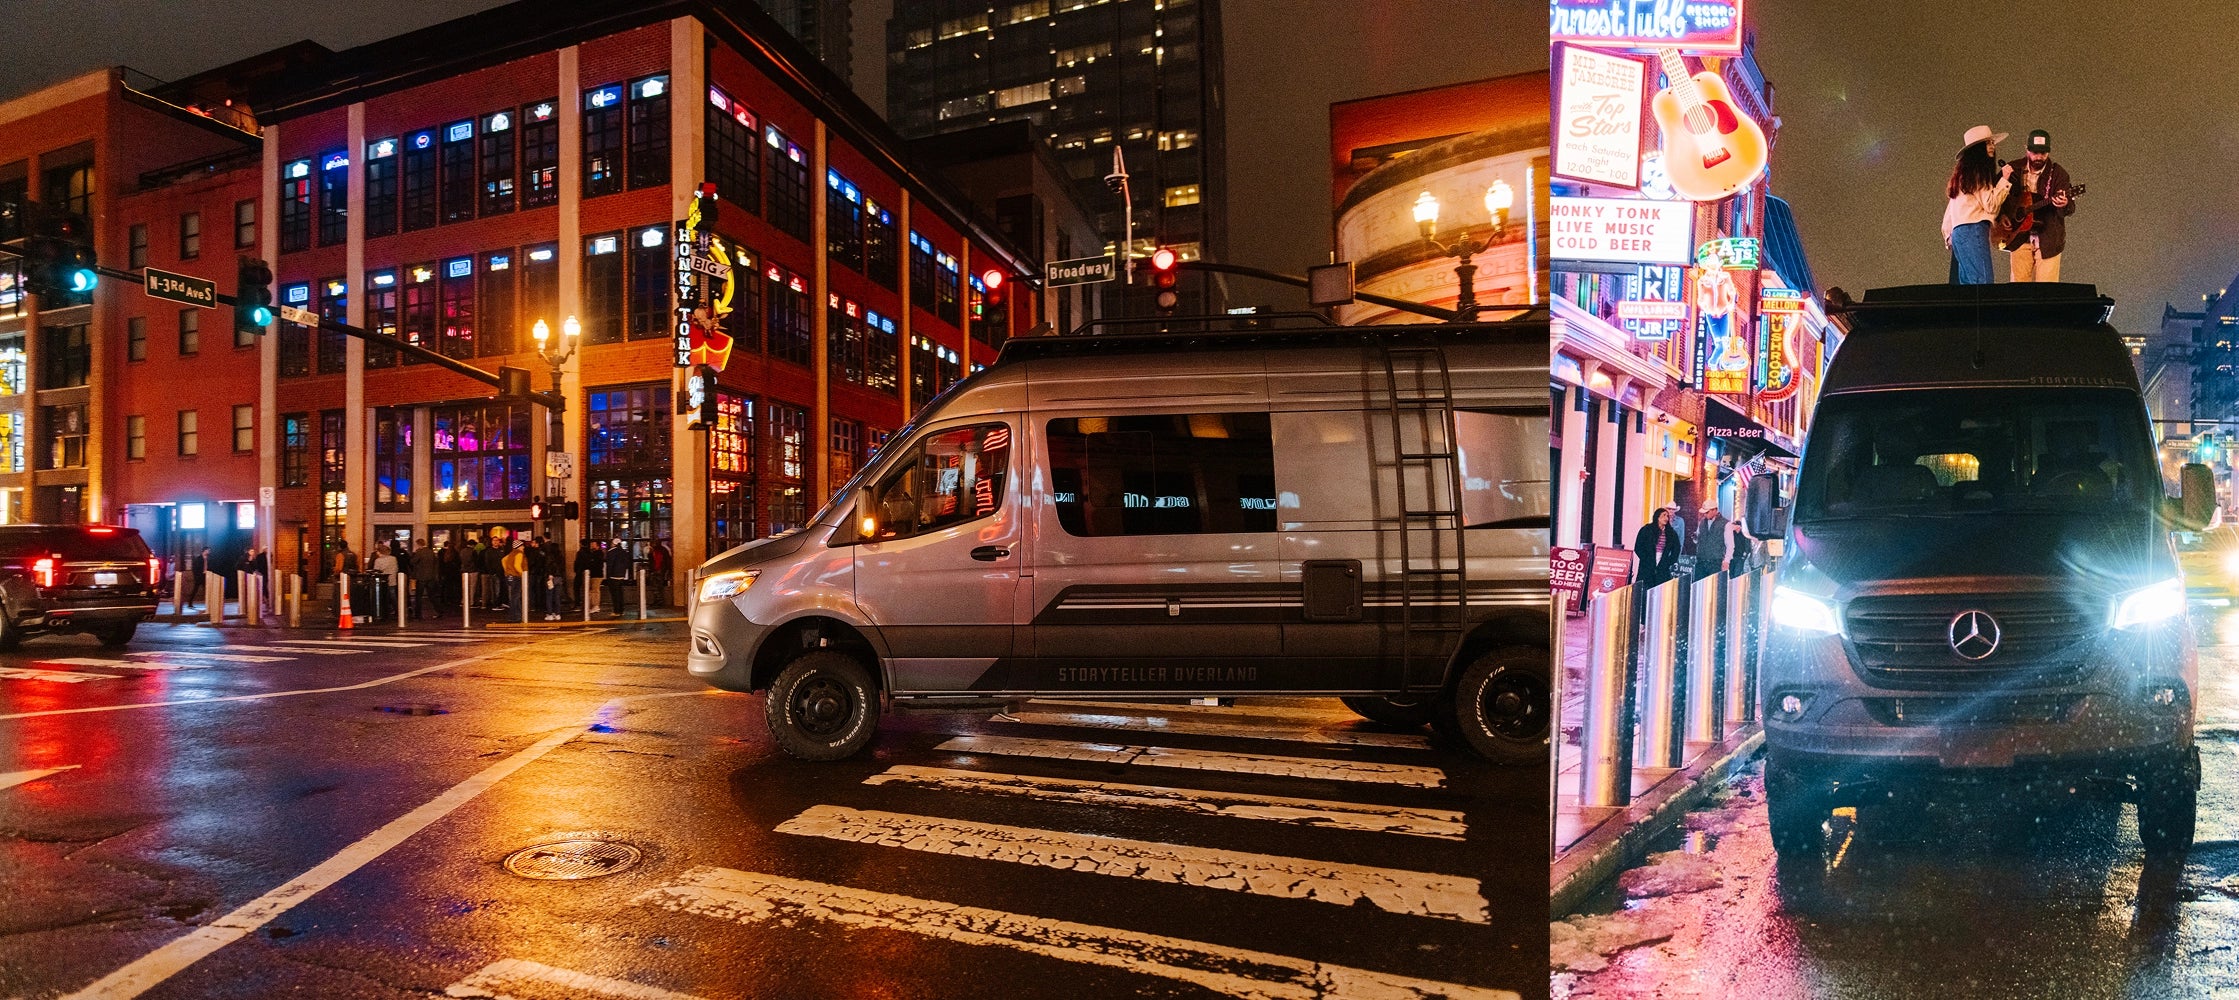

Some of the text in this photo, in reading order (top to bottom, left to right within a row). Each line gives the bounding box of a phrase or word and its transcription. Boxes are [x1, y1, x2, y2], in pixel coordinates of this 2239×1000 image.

[1686, 5, 1736, 17] RECORD
[1627, 0, 1687, 38] Tubb
[1695, 16, 1729, 27] SHOP
[1573, 55, 1636, 78] MID NITE
[1570, 68, 1635, 92] JAMBOREE
[1570, 94, 1625, 120] with Top
[1569, 115, 1632, 138] Stars
[1566, 142, 1632, 160] each Saturday
[1588, 156, 1609, 167] night
[1567, 162, 1592, 174] 12:00
[1609, 169, 1629, 181] 1:00
[1550, 205, 1661, 220] HONKY TONK
[1557, 221, 1655, 236] LIVE MUSIC
[1557, 237, 1652, 252] COLD BEER
[693, 259, 717, 275] BIG
[1050, 263, 1110, 280] Broadway
[678, 229, 690, 365] HONKY TONK
[1621, 303, 1681, 316] WILLIAMS
[1762, 301, 1799, 310] MELLOW
[1641, 321, 1663, 335] JR
[1767, 314, 1784, 388] MUSHROOM
[1695, 343, 1704, 389] JACKSON
[1708, 378, 1742, 392] BAR
[2030, 376, 2114, 385] STORYTELLER
[1707, 426, 1762, 438] Pizza Beer
[1551, 560, 1584, 571] TO GO
[1059, 667, 1258, 682] STORYTELLER OVERLAND
